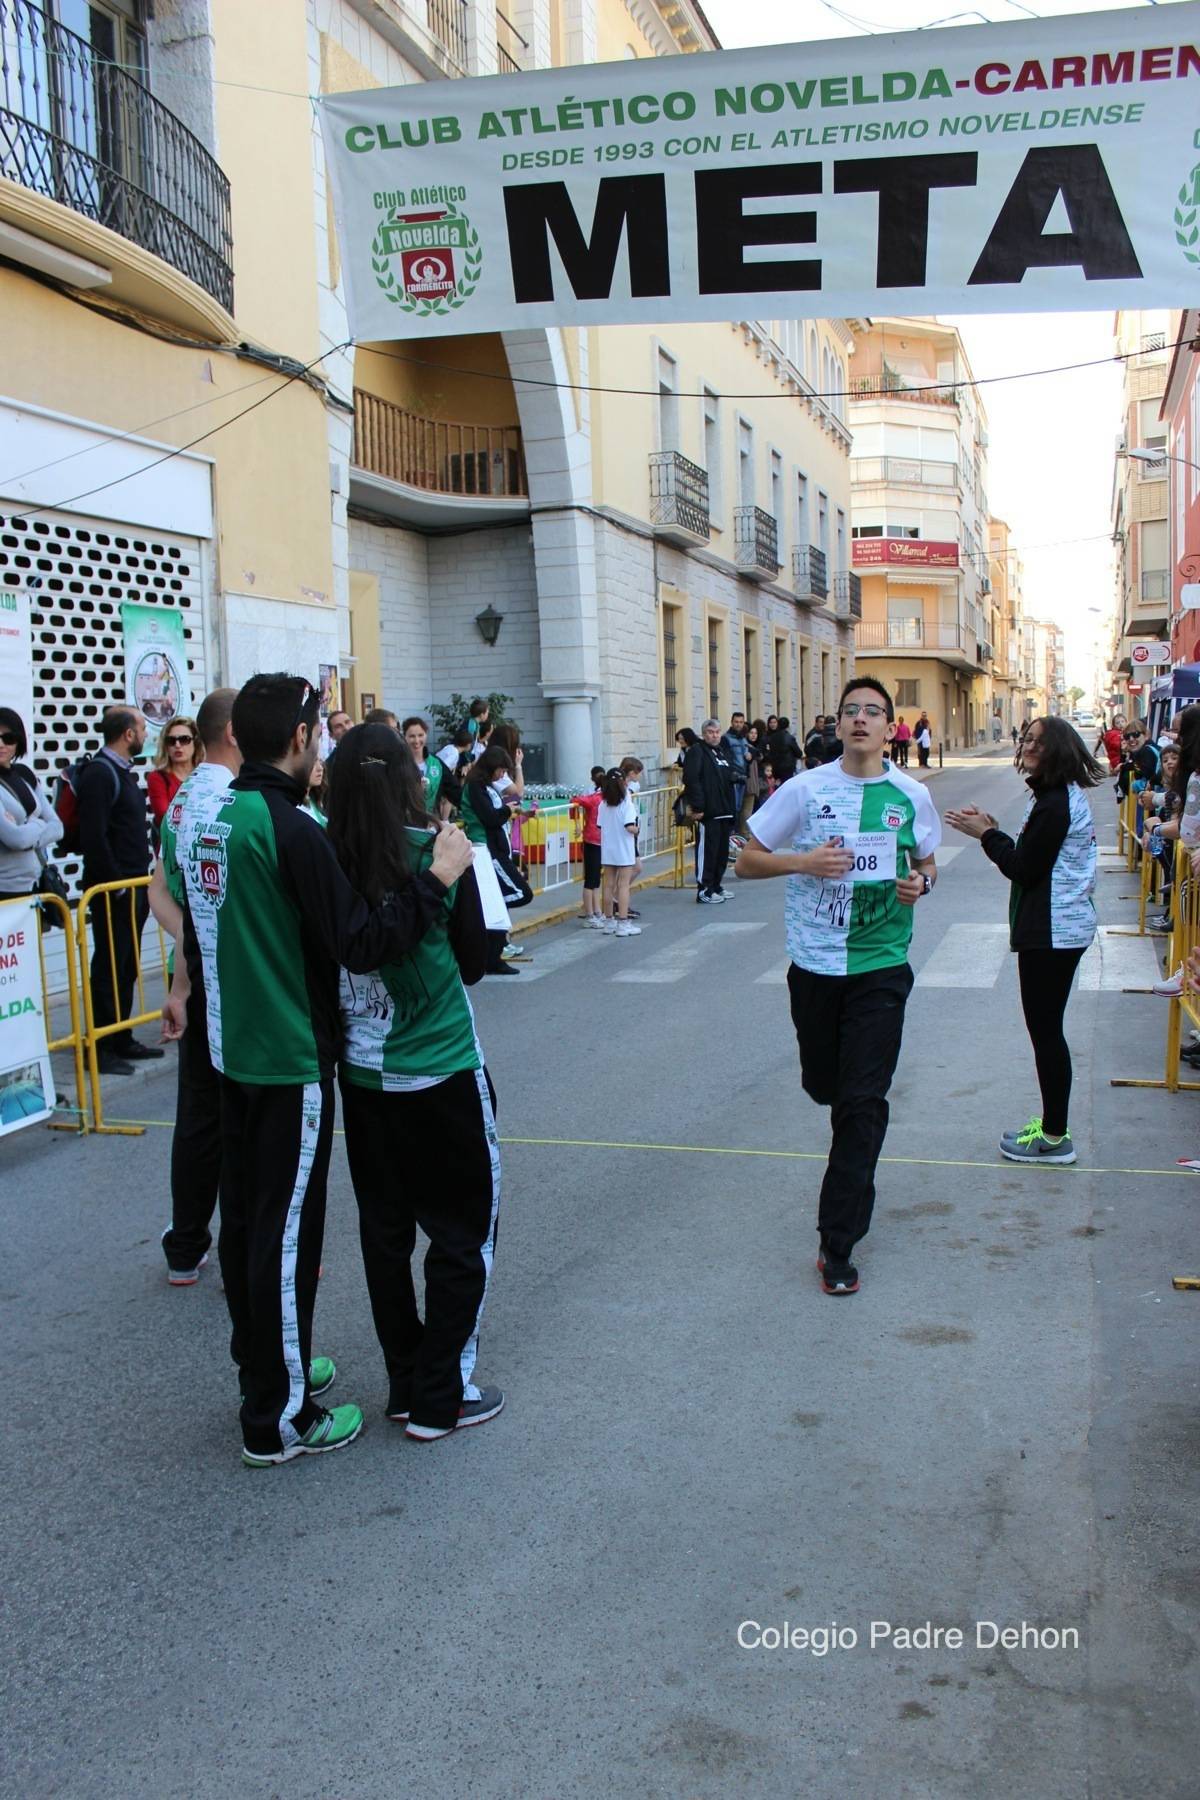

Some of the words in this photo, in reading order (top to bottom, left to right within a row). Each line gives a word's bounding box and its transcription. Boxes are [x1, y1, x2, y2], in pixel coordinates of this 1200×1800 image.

[344, 116, 461, 153] CLUB
[477, 91, 696, 140] ATLÉTICO
[502, 147, 584, 171] DESDE
[595, 141, 655, 162] 1993
[664, 134, 722, 157] CON
[730, 133, 762, 152] EL
[771, 119, 929, 149] ATLETISMO
[938, 102, 1146, 137] NOVELDENSE
[373, 189, 406, 209] Club
[410, 185, 466, 206] Atlético
[389, 225, 460, 251] Novelda
[502, 143, 1144, 304] META
[7, 931, 25, 949] DE
